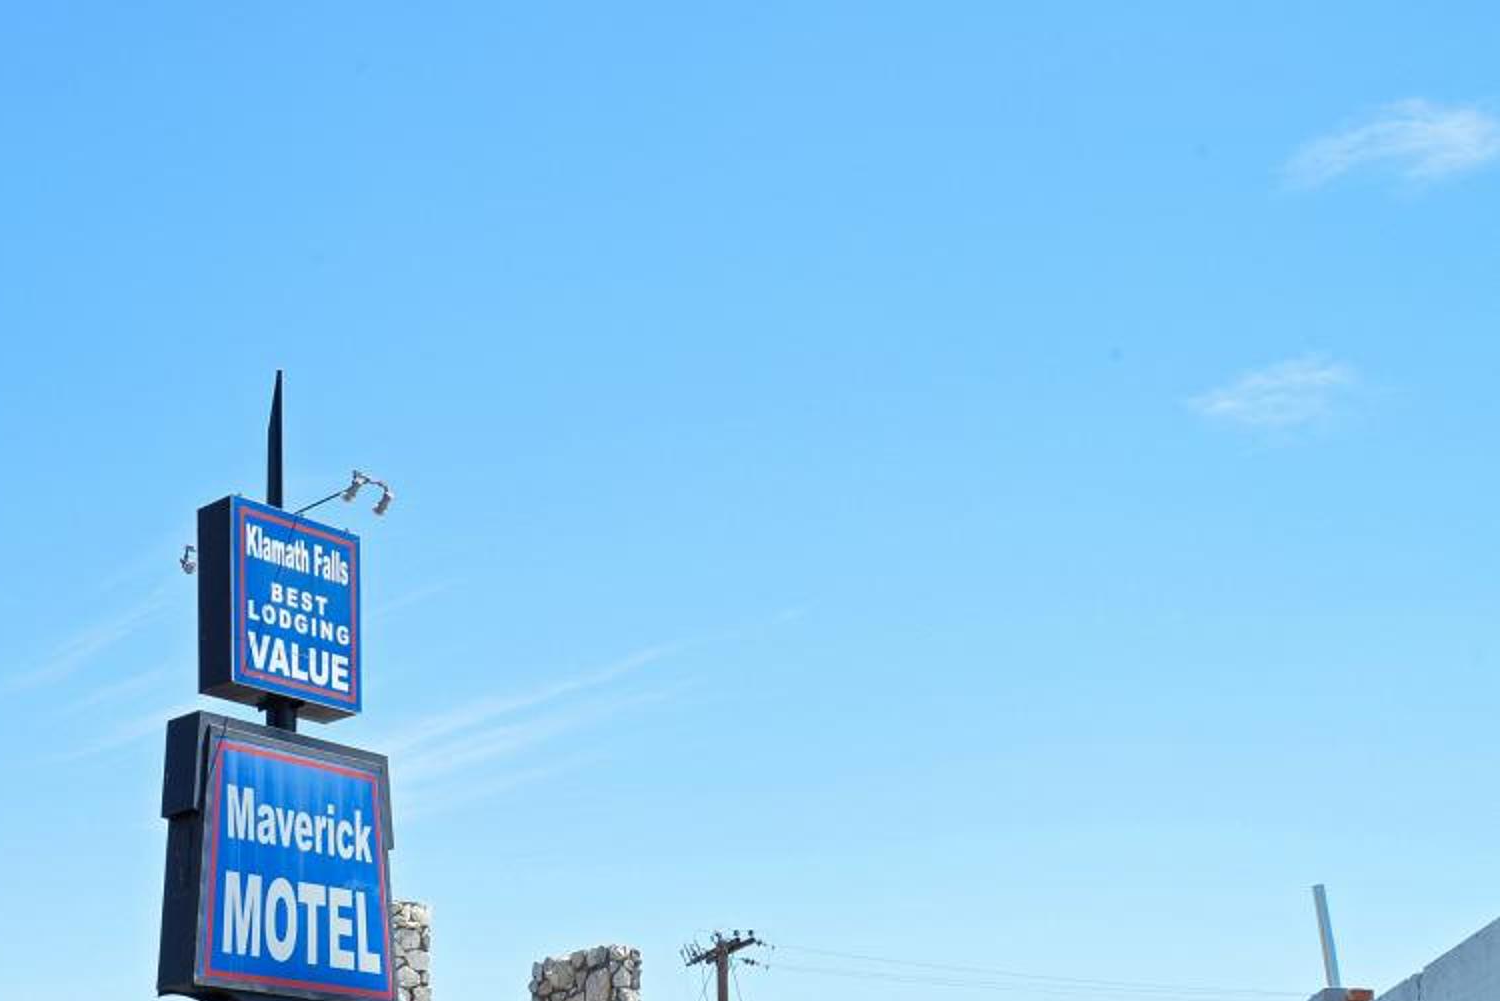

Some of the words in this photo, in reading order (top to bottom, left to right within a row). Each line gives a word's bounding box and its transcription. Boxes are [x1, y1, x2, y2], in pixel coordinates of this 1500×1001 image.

[245, 523, 309, 574] Klamath
[313, 544, 349, 586] Falls
[248, 600, 349, 645] LODGING
[271, 582, 327, 615] BEST
[248, 632, 349, 692] VALUE
[226, 783, 372, 863] Maverick
[222, 870, 381, 974] MOTEL
